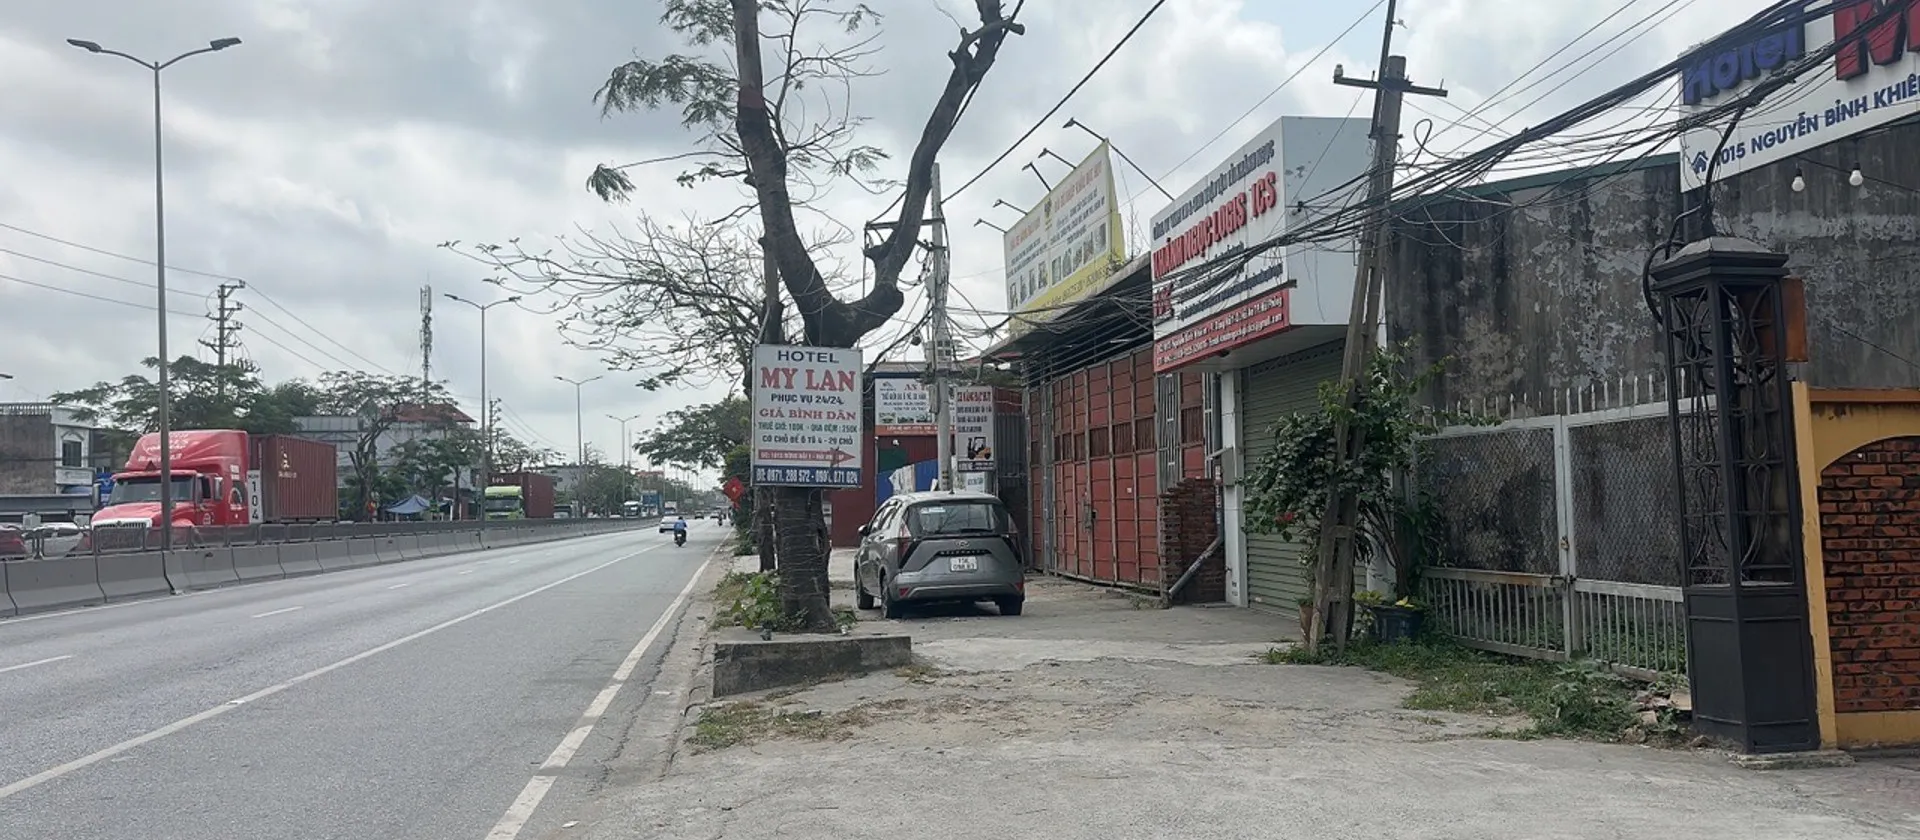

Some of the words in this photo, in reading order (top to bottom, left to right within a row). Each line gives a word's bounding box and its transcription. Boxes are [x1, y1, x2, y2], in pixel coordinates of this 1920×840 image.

[1751, 111, 1819, 154] NGUYỄN
[1824, 99, 1868, 127] BỈNH
[1873, 73, 1920, 109] KHIÊ
[778, 350, 839, 363] HOTEL
[761, 366, 798, 389] MY
[806, 369, 856, 392] LAN
[771, 393, 797, 404] PHỤC
[800, 394, 813, 405] VỤ
[759, 406, 784, 417] GIÁ
[789, 407, 823, 419] BÌNH
[827, 409, 856, 420] DÂN
